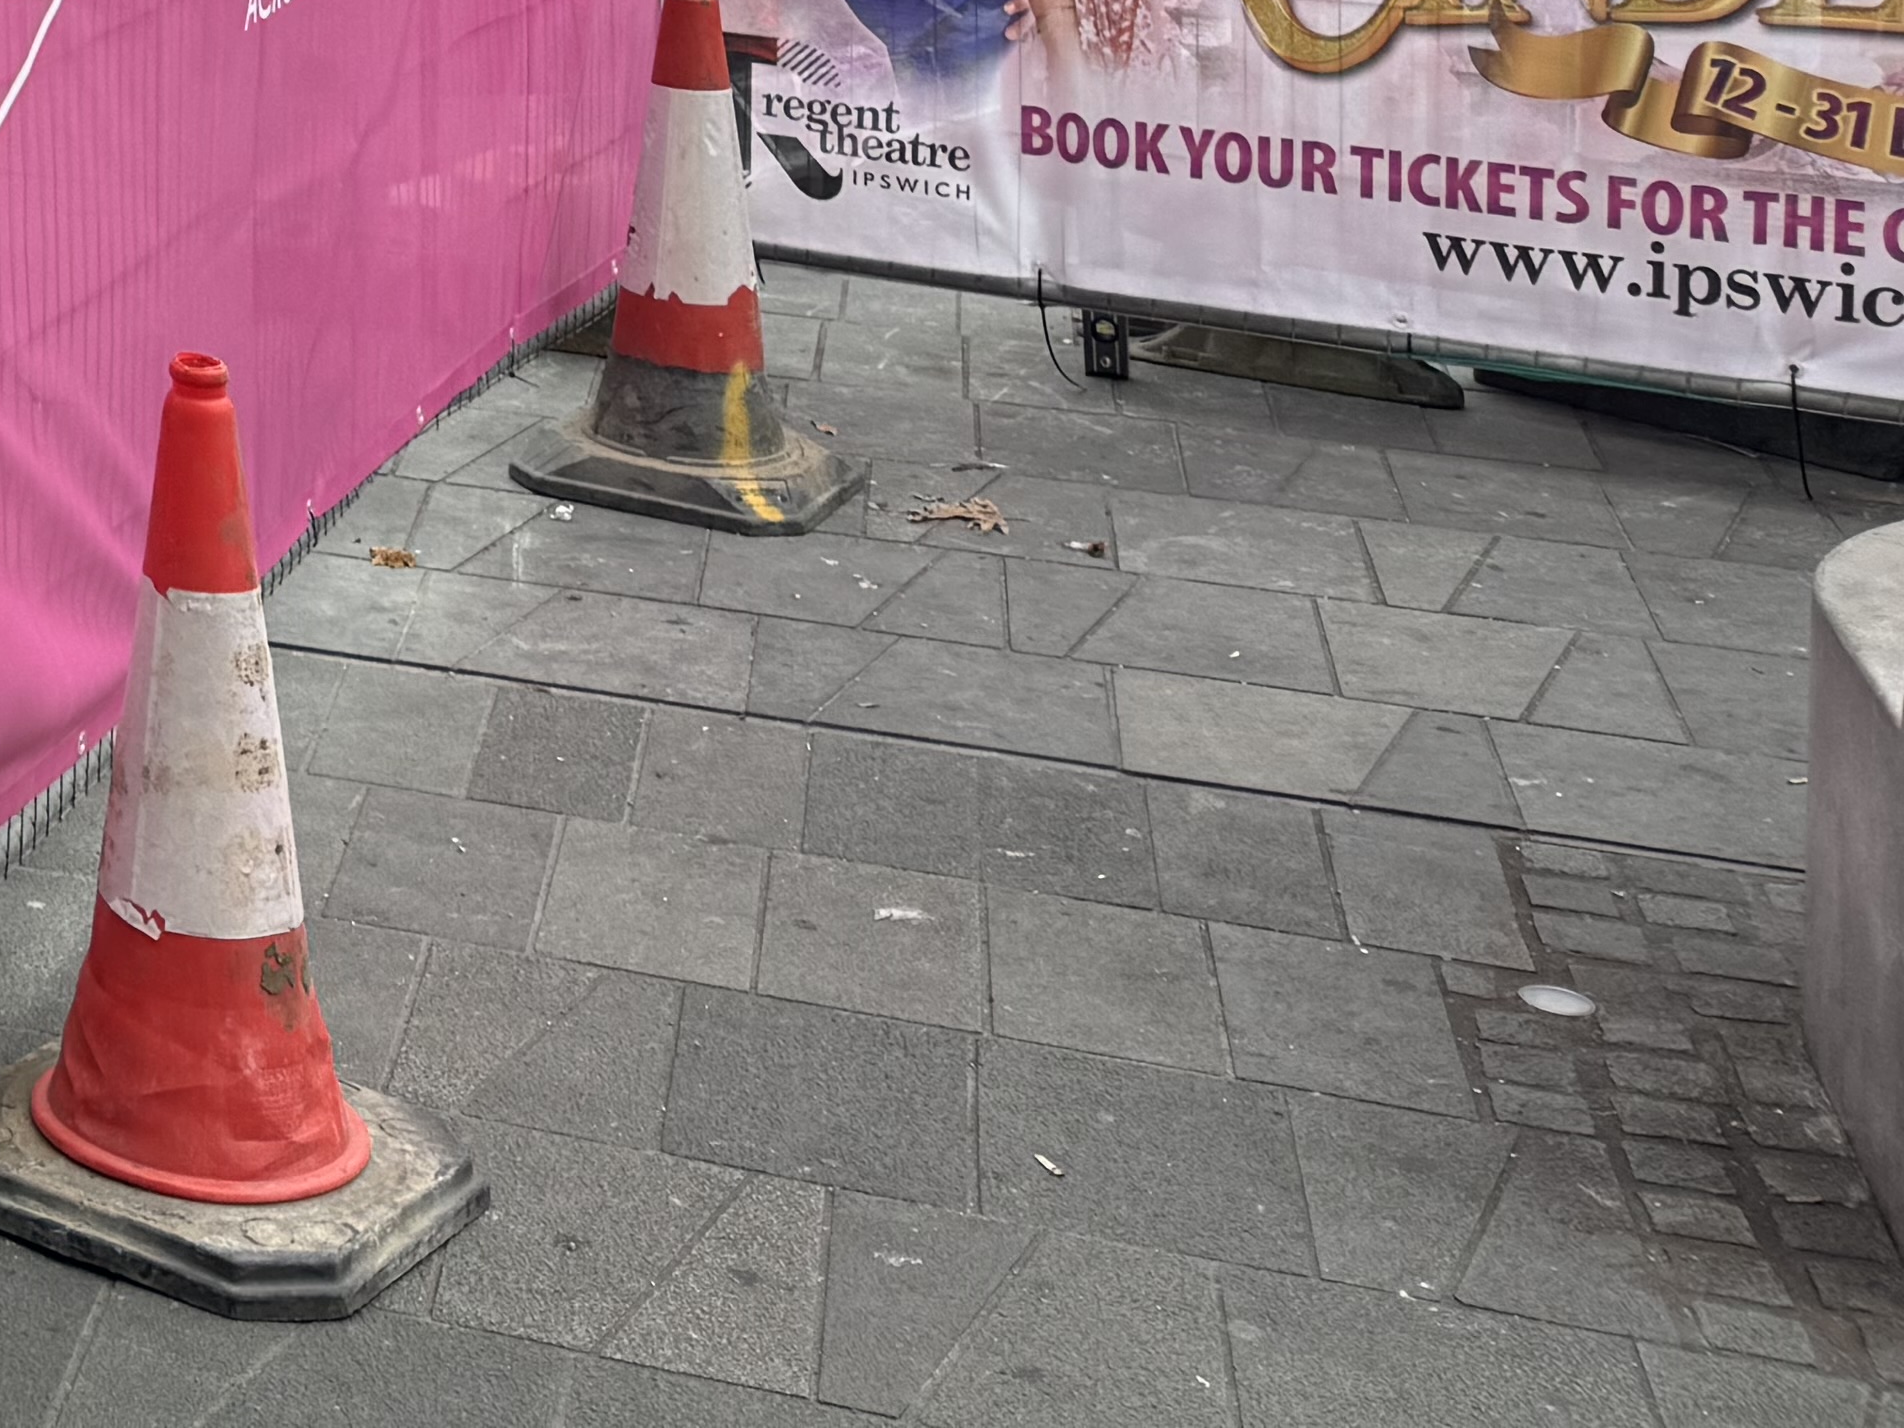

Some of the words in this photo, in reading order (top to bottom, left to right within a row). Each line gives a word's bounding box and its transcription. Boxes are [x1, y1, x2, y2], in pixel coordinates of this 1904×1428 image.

[761, 91, 901, 135] regent
[1700, 57, 1768, 120] 12
[1803, 91, 1873, 152] 31
[819, 129, 972, 173] theatre
[852, 169, 972, 202] IPSWICH
[1020, 104, 1172, 177] BOOK
[1180, 124, 1339, 195] YOUR
[1350, 145, 1590, 226] TICKETS
[1606, 175, 1730, 244] FOR
[1742, 190, 1866, 258] THE
